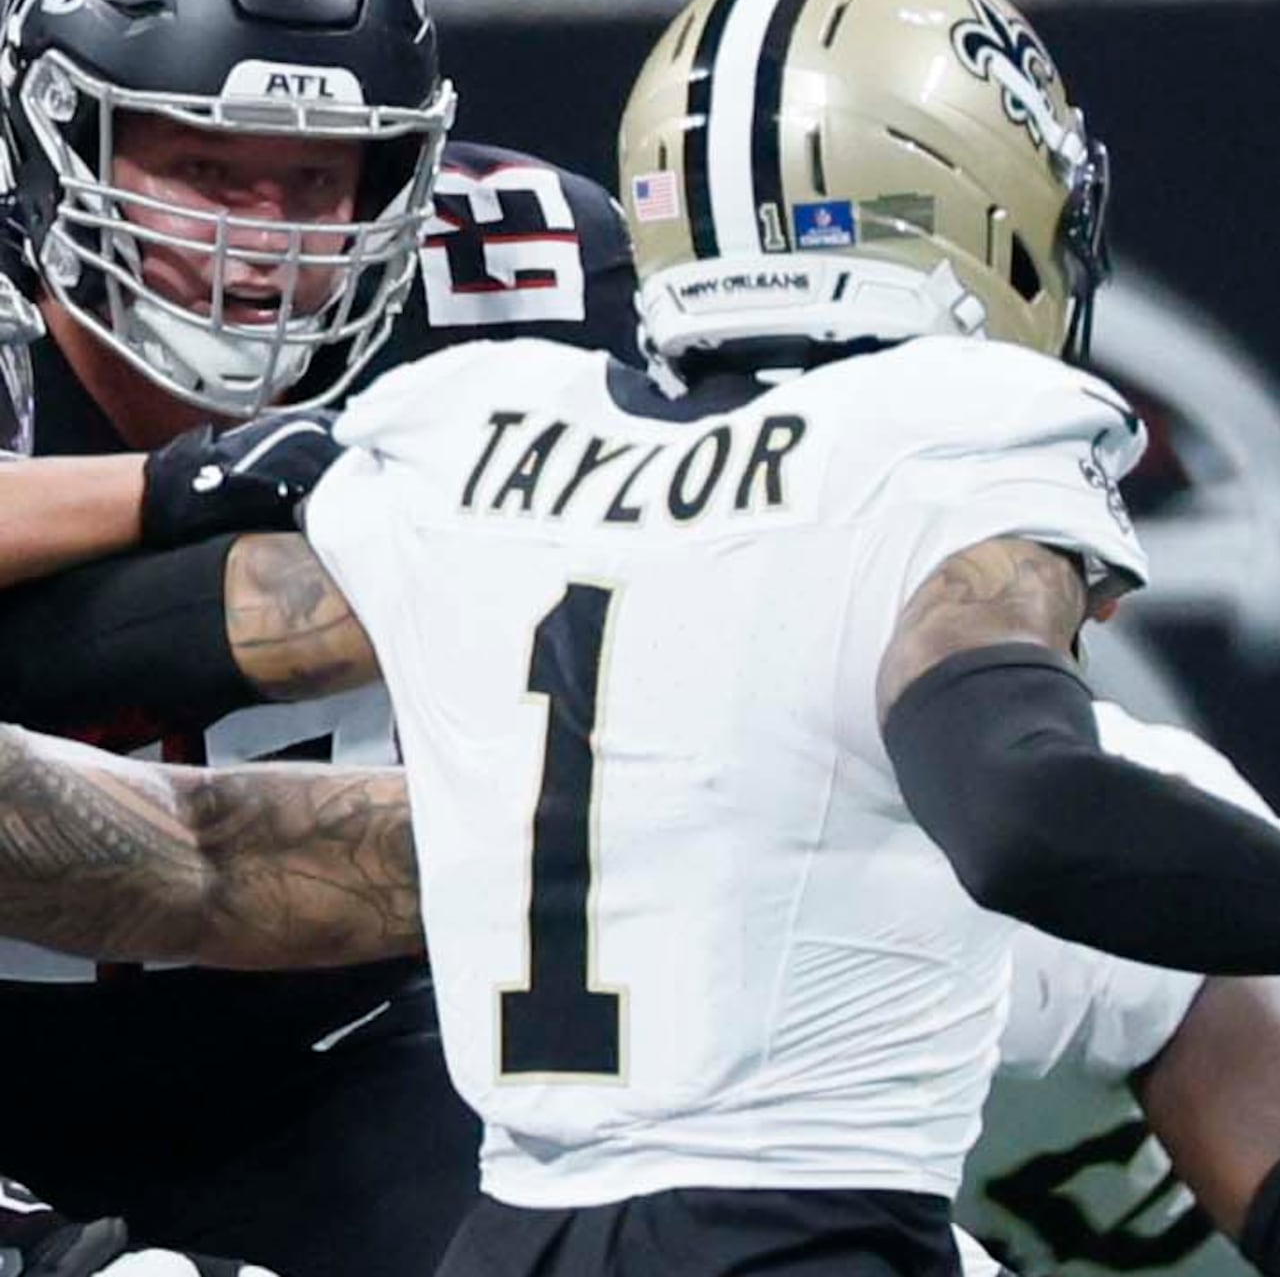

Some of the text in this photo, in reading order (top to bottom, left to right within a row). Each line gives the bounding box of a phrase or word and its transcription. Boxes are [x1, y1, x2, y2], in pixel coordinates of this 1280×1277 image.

[265, 72, 334, 98] ATL
[758, 201, 786, 252] 1
[680, 272, 810, 297] NEW ORLEANS
[459, 410, 808, 523] TAYLOR
[496, 580, 626, 1082] 1
